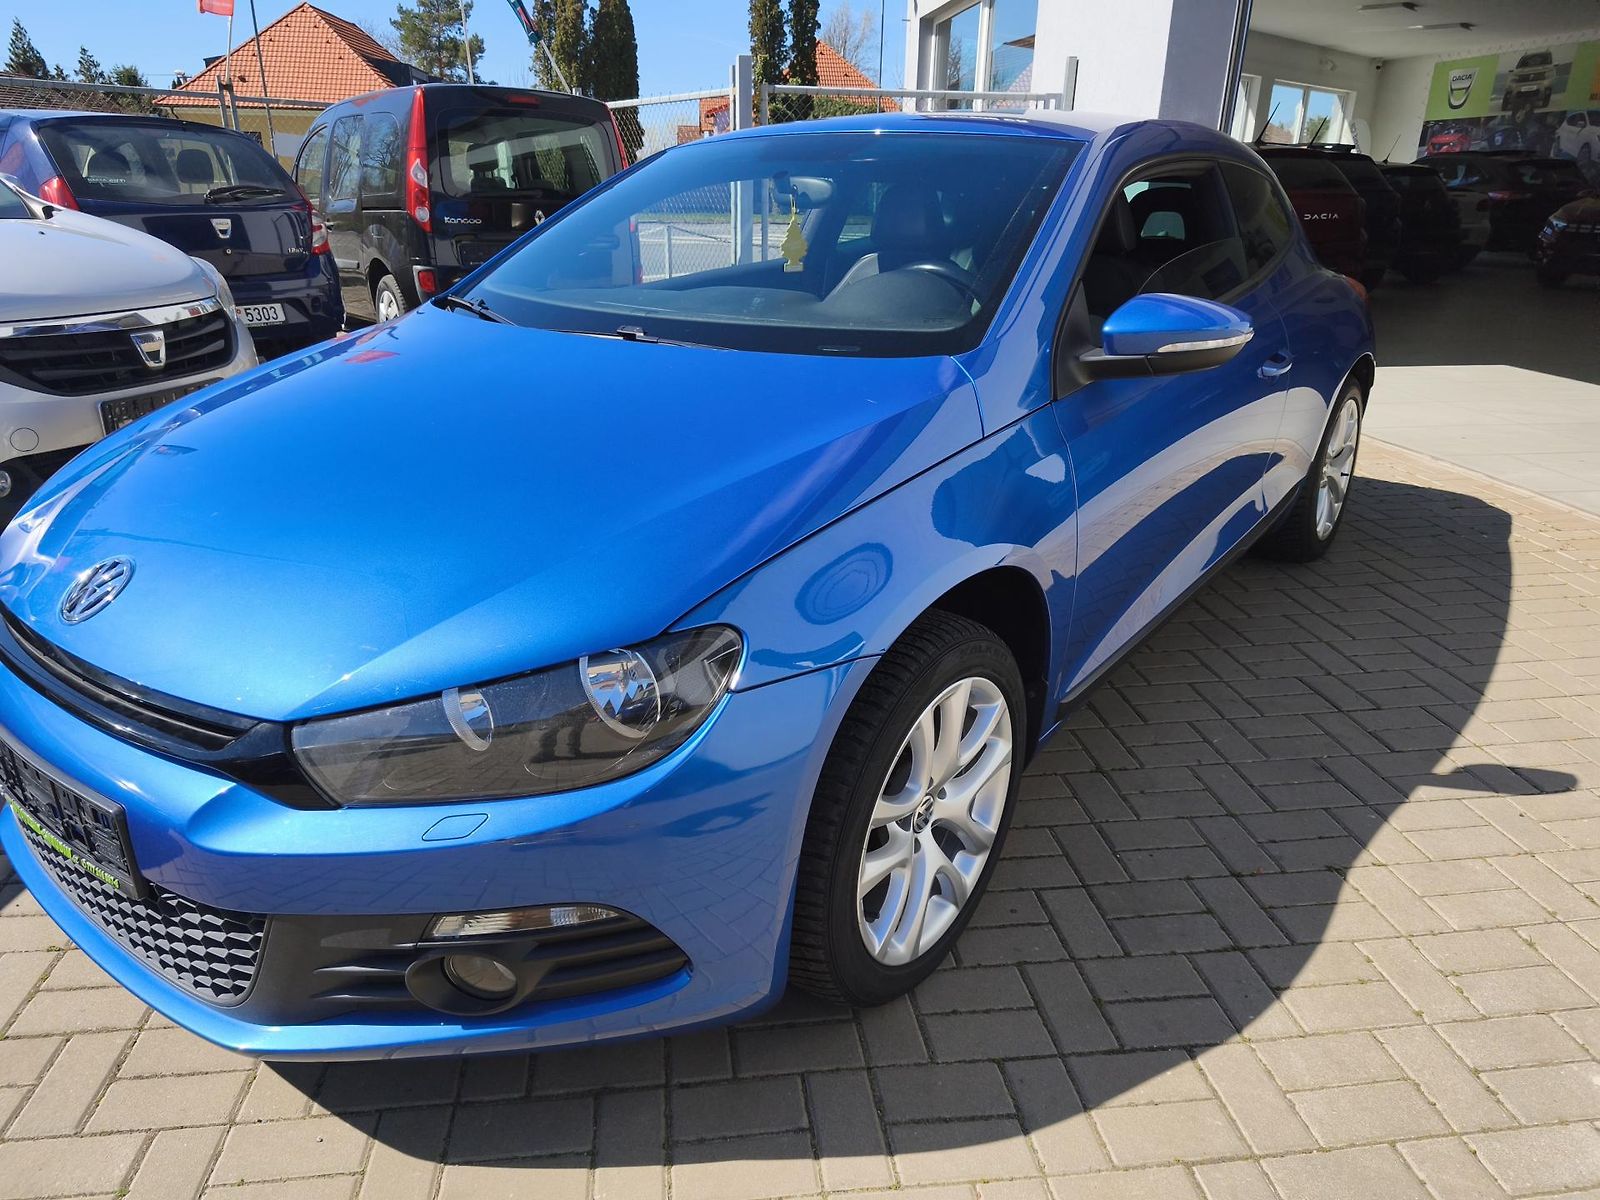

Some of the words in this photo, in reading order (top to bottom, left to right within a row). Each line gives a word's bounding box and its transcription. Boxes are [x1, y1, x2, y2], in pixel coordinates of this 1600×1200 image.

[1452, 73, 1472, 81] DACIA
[444, 216, 482, 225] Kangoo
[244, 306, 279, 322] 5303
